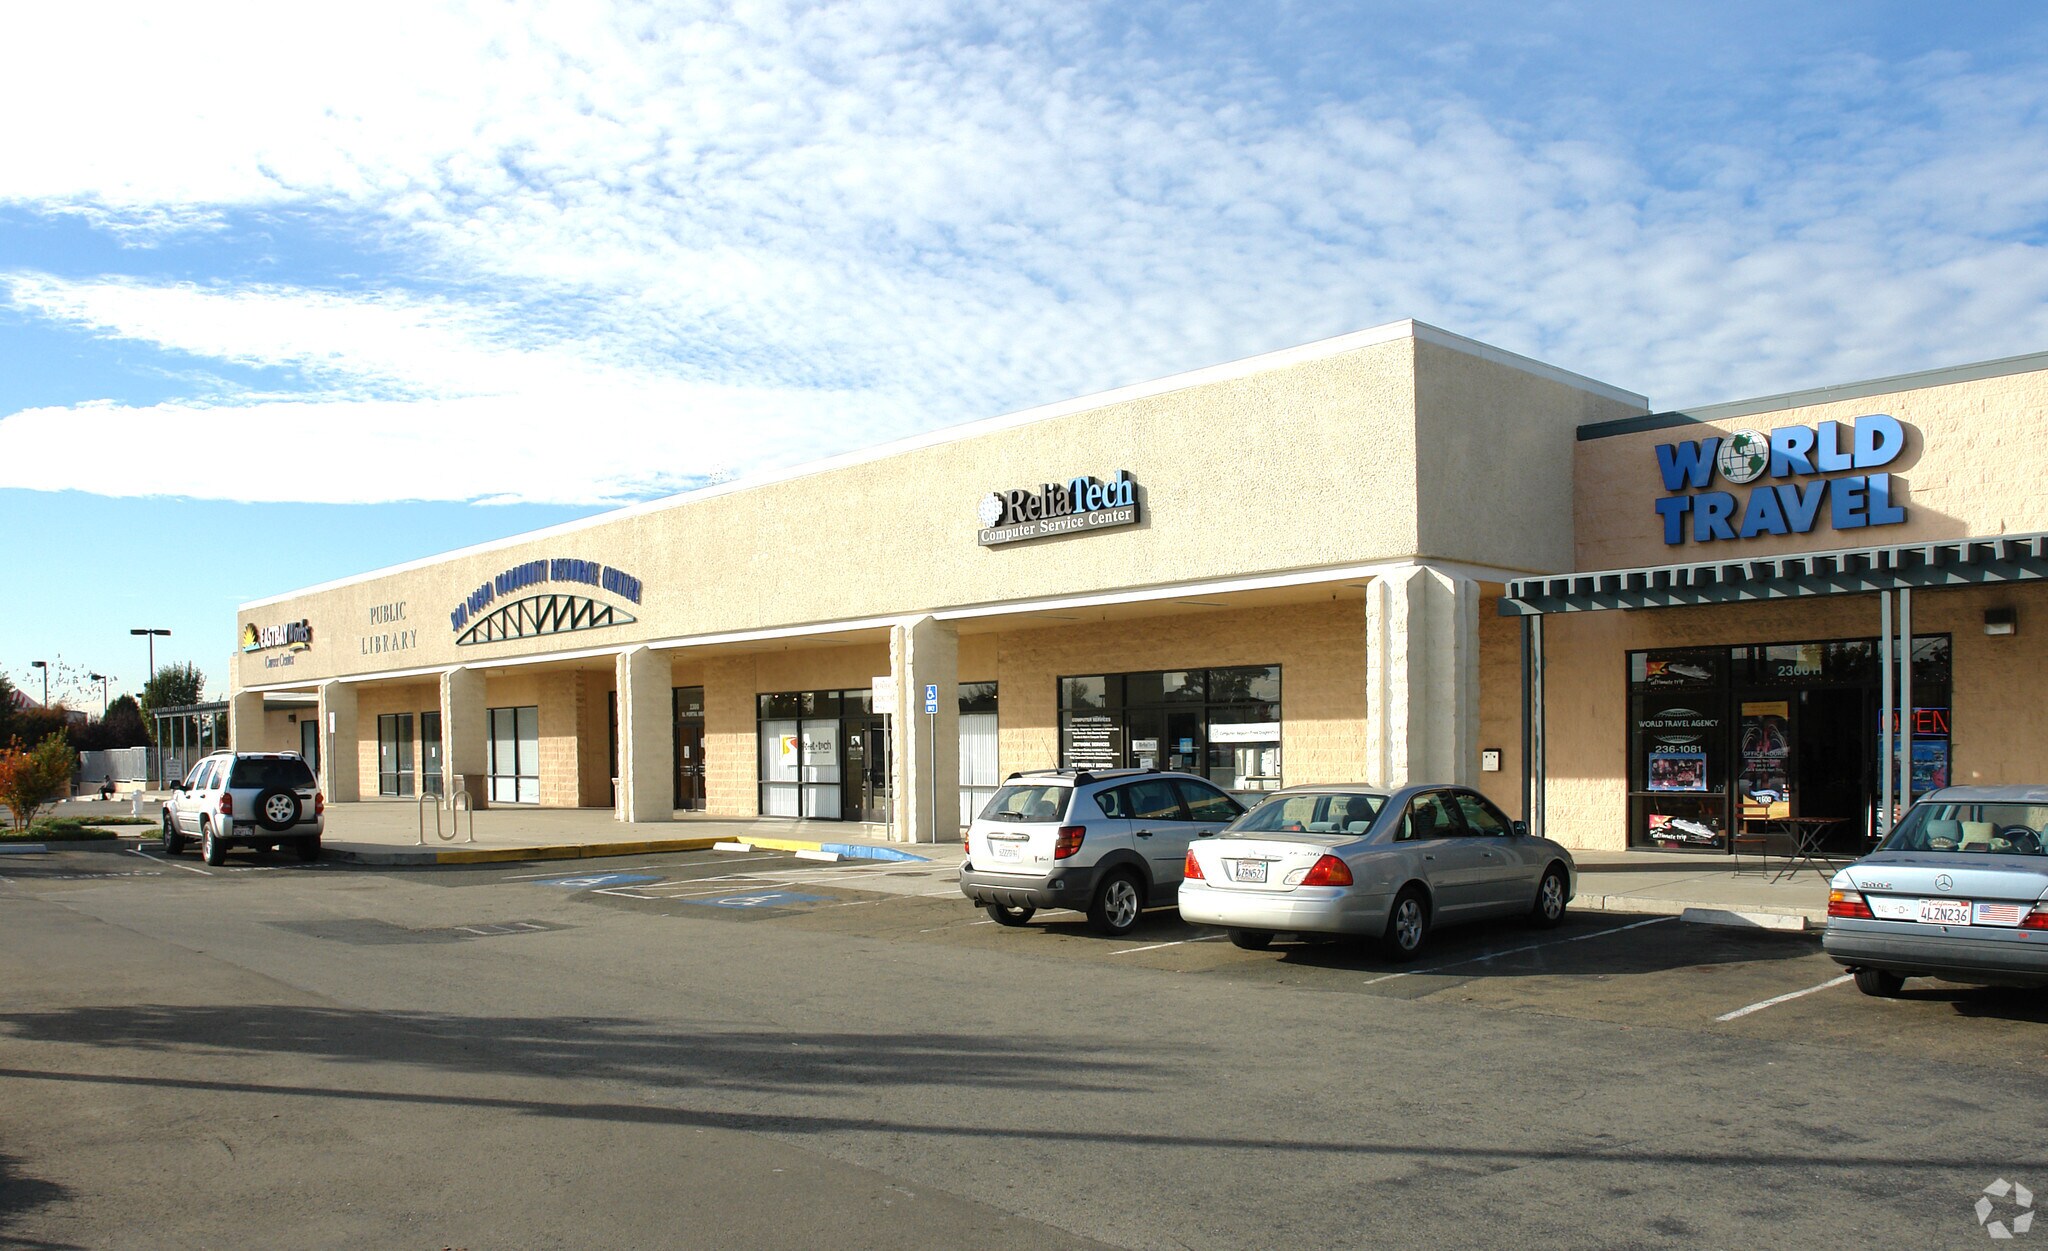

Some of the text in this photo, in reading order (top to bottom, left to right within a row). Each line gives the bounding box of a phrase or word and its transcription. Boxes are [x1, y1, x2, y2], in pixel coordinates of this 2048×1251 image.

[1655, 414, 1905, 491] WORLD
[1004, 469, 1135, 524] ReliaTech
[1655, 473, 1906, 544] TRAVEL
[980, 509, 1132, 542] Computer Service Center
[369, 601, 407, 626] PUBLIC
[361, 629, 417, 655] LIBRARY
[1777, 665, 1810, 677] 2300
[1638, 720, 1664, 728] WORLD
[1690, 719, 1719, 727] AGENCY
[1655, 745, 1702, 753] 236-1081
[1920, 906, 1967, 922] 4LZN236
